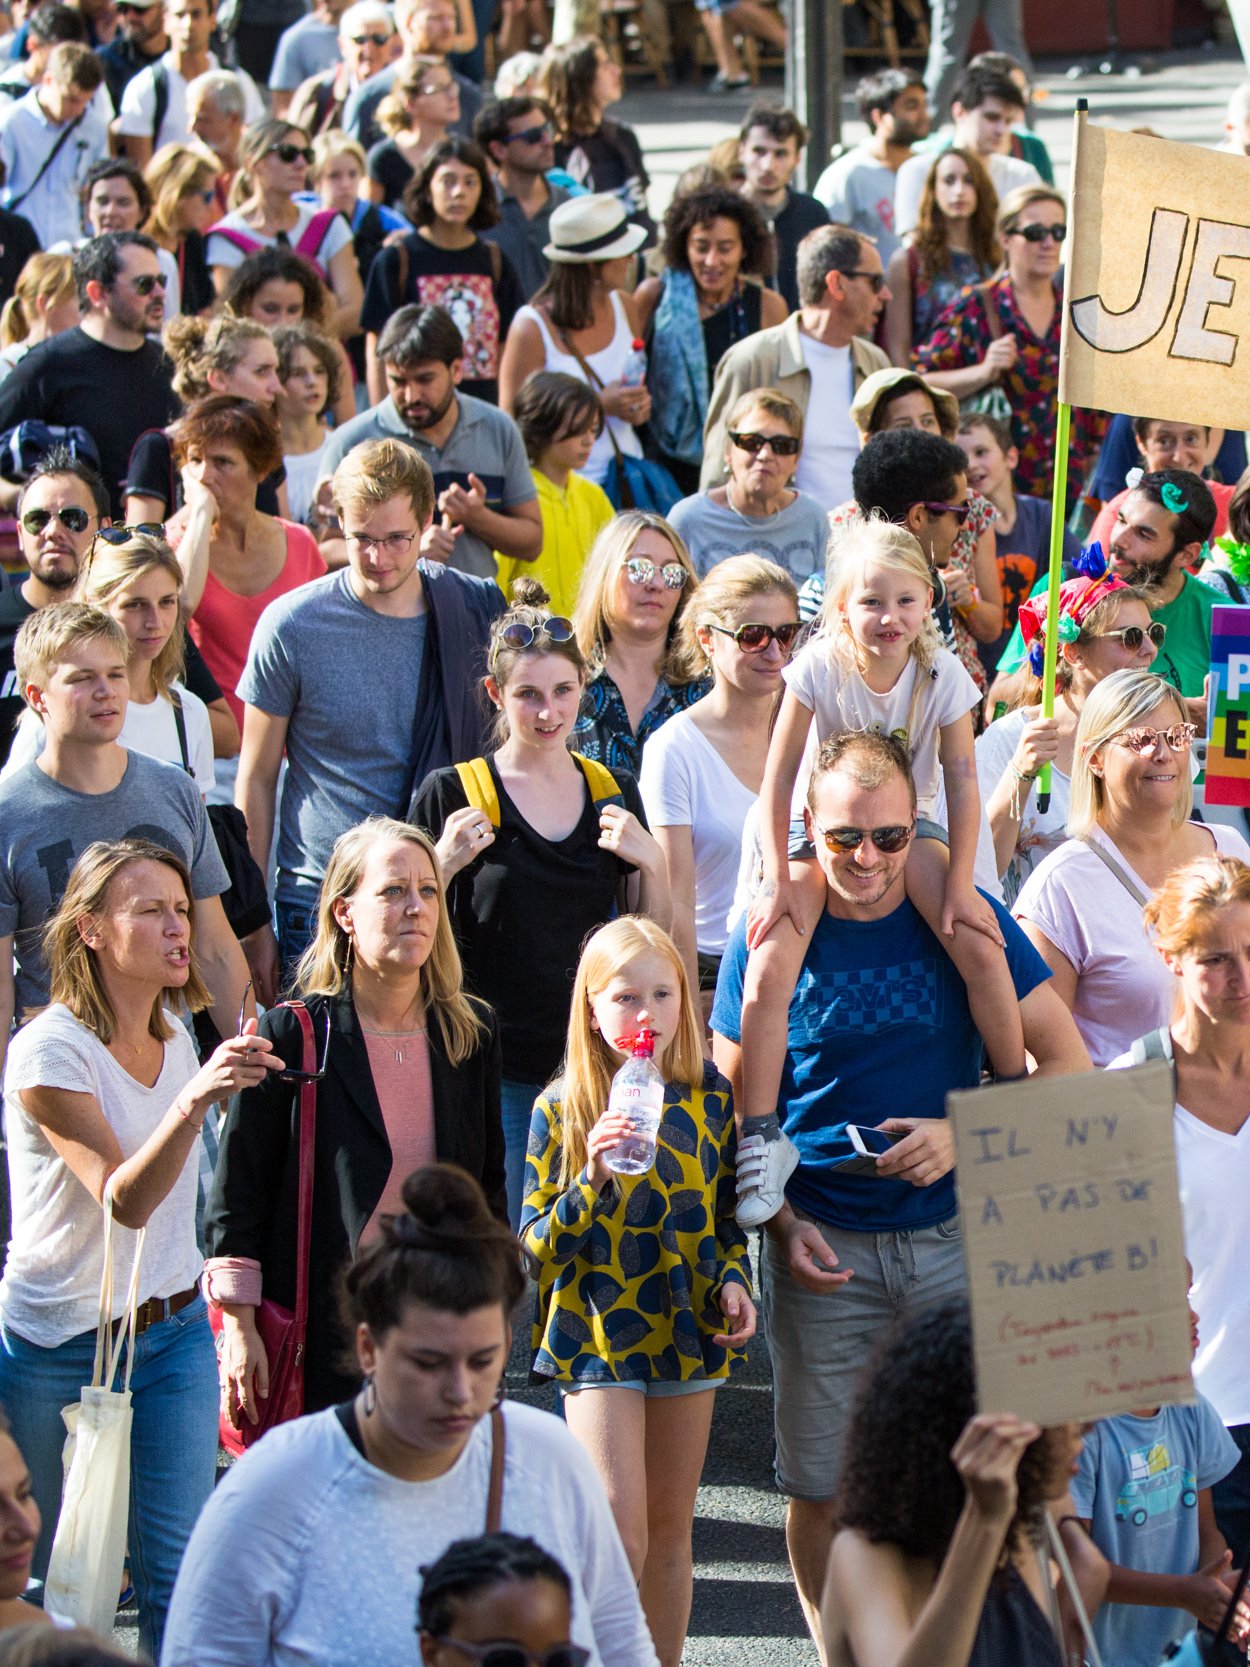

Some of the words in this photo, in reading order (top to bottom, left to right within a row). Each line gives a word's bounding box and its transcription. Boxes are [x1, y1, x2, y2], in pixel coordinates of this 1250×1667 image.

[970, 1127, 1032, 1165] IL
[1065, 1112, 1119, 1146] N'Y
[981, 1195, 1003, 1226] A
[1034, 1181, 1100, 1213] PAS
[1113, 1177, 1155, 1202] DE
